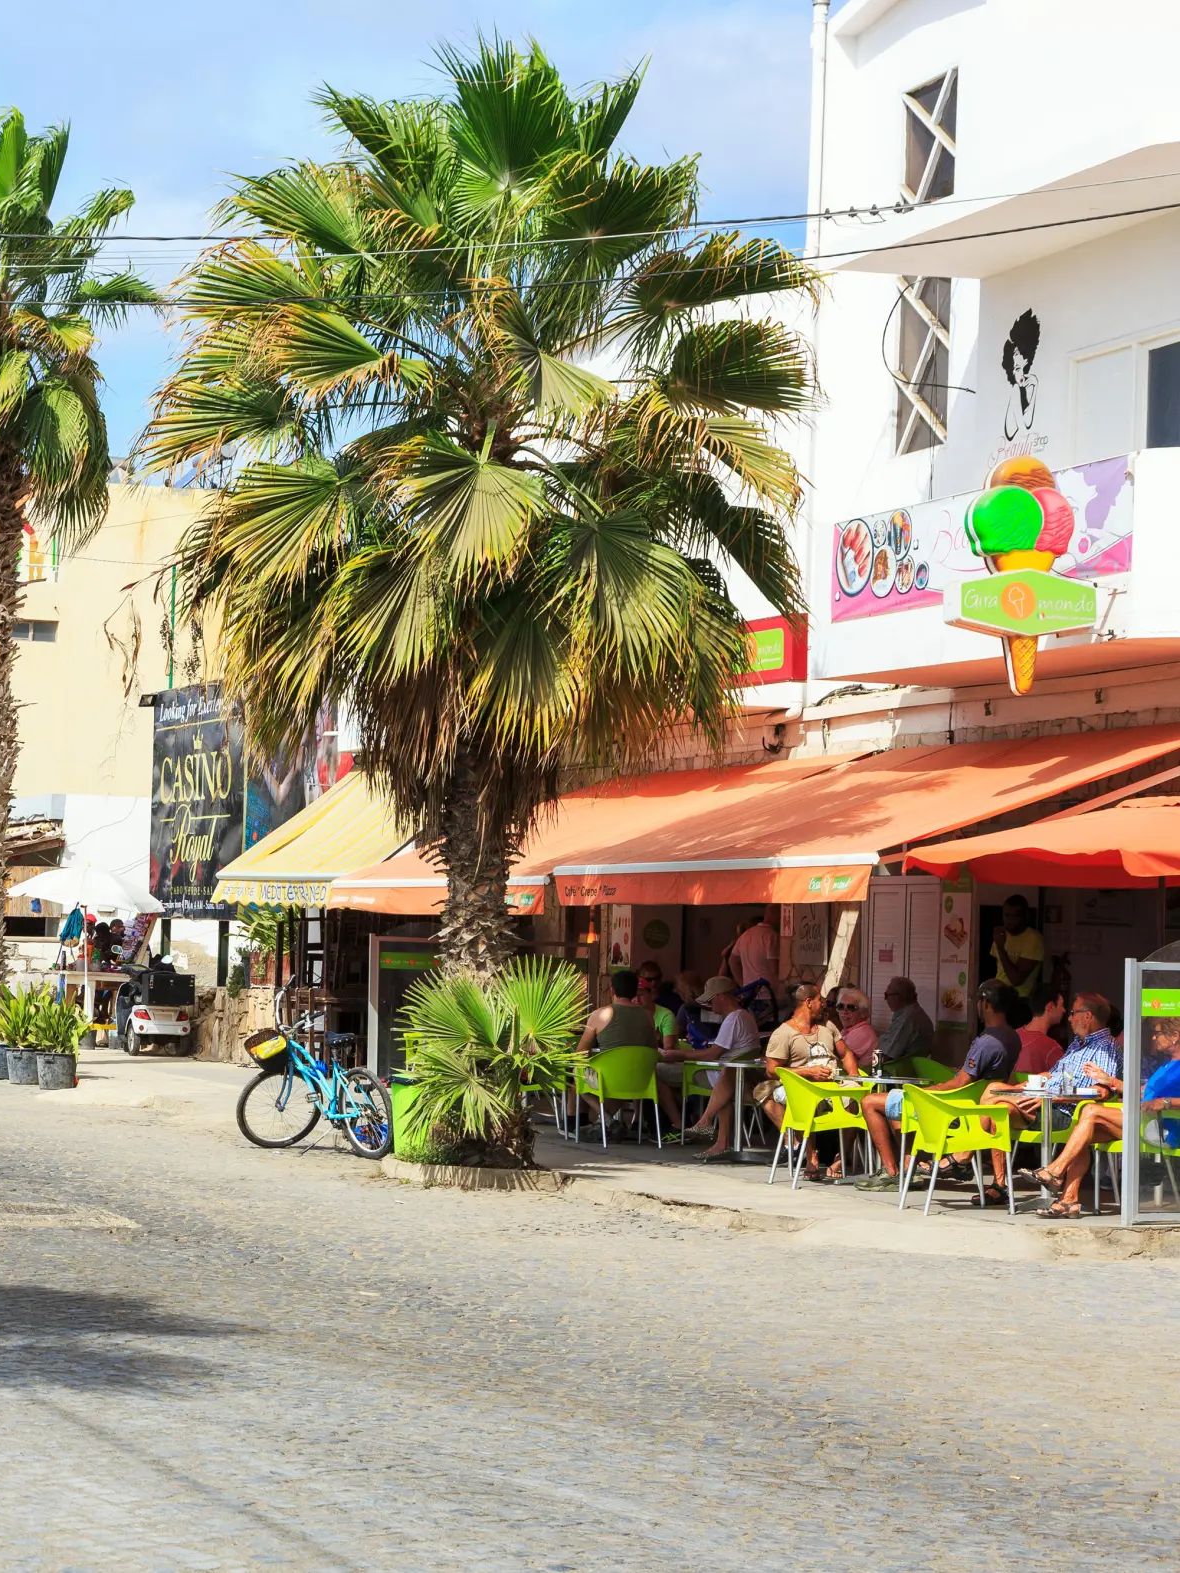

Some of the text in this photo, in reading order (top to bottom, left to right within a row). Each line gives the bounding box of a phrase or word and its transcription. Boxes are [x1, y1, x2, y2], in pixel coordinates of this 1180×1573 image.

[963, 588, 1095, 612] Gira mondo
[160, 701, 186, 723] Looking
[186, 698, 197, 722] for
[160, 751, 232, 805] CASINO
[169, 804, 223, 882] Royal
